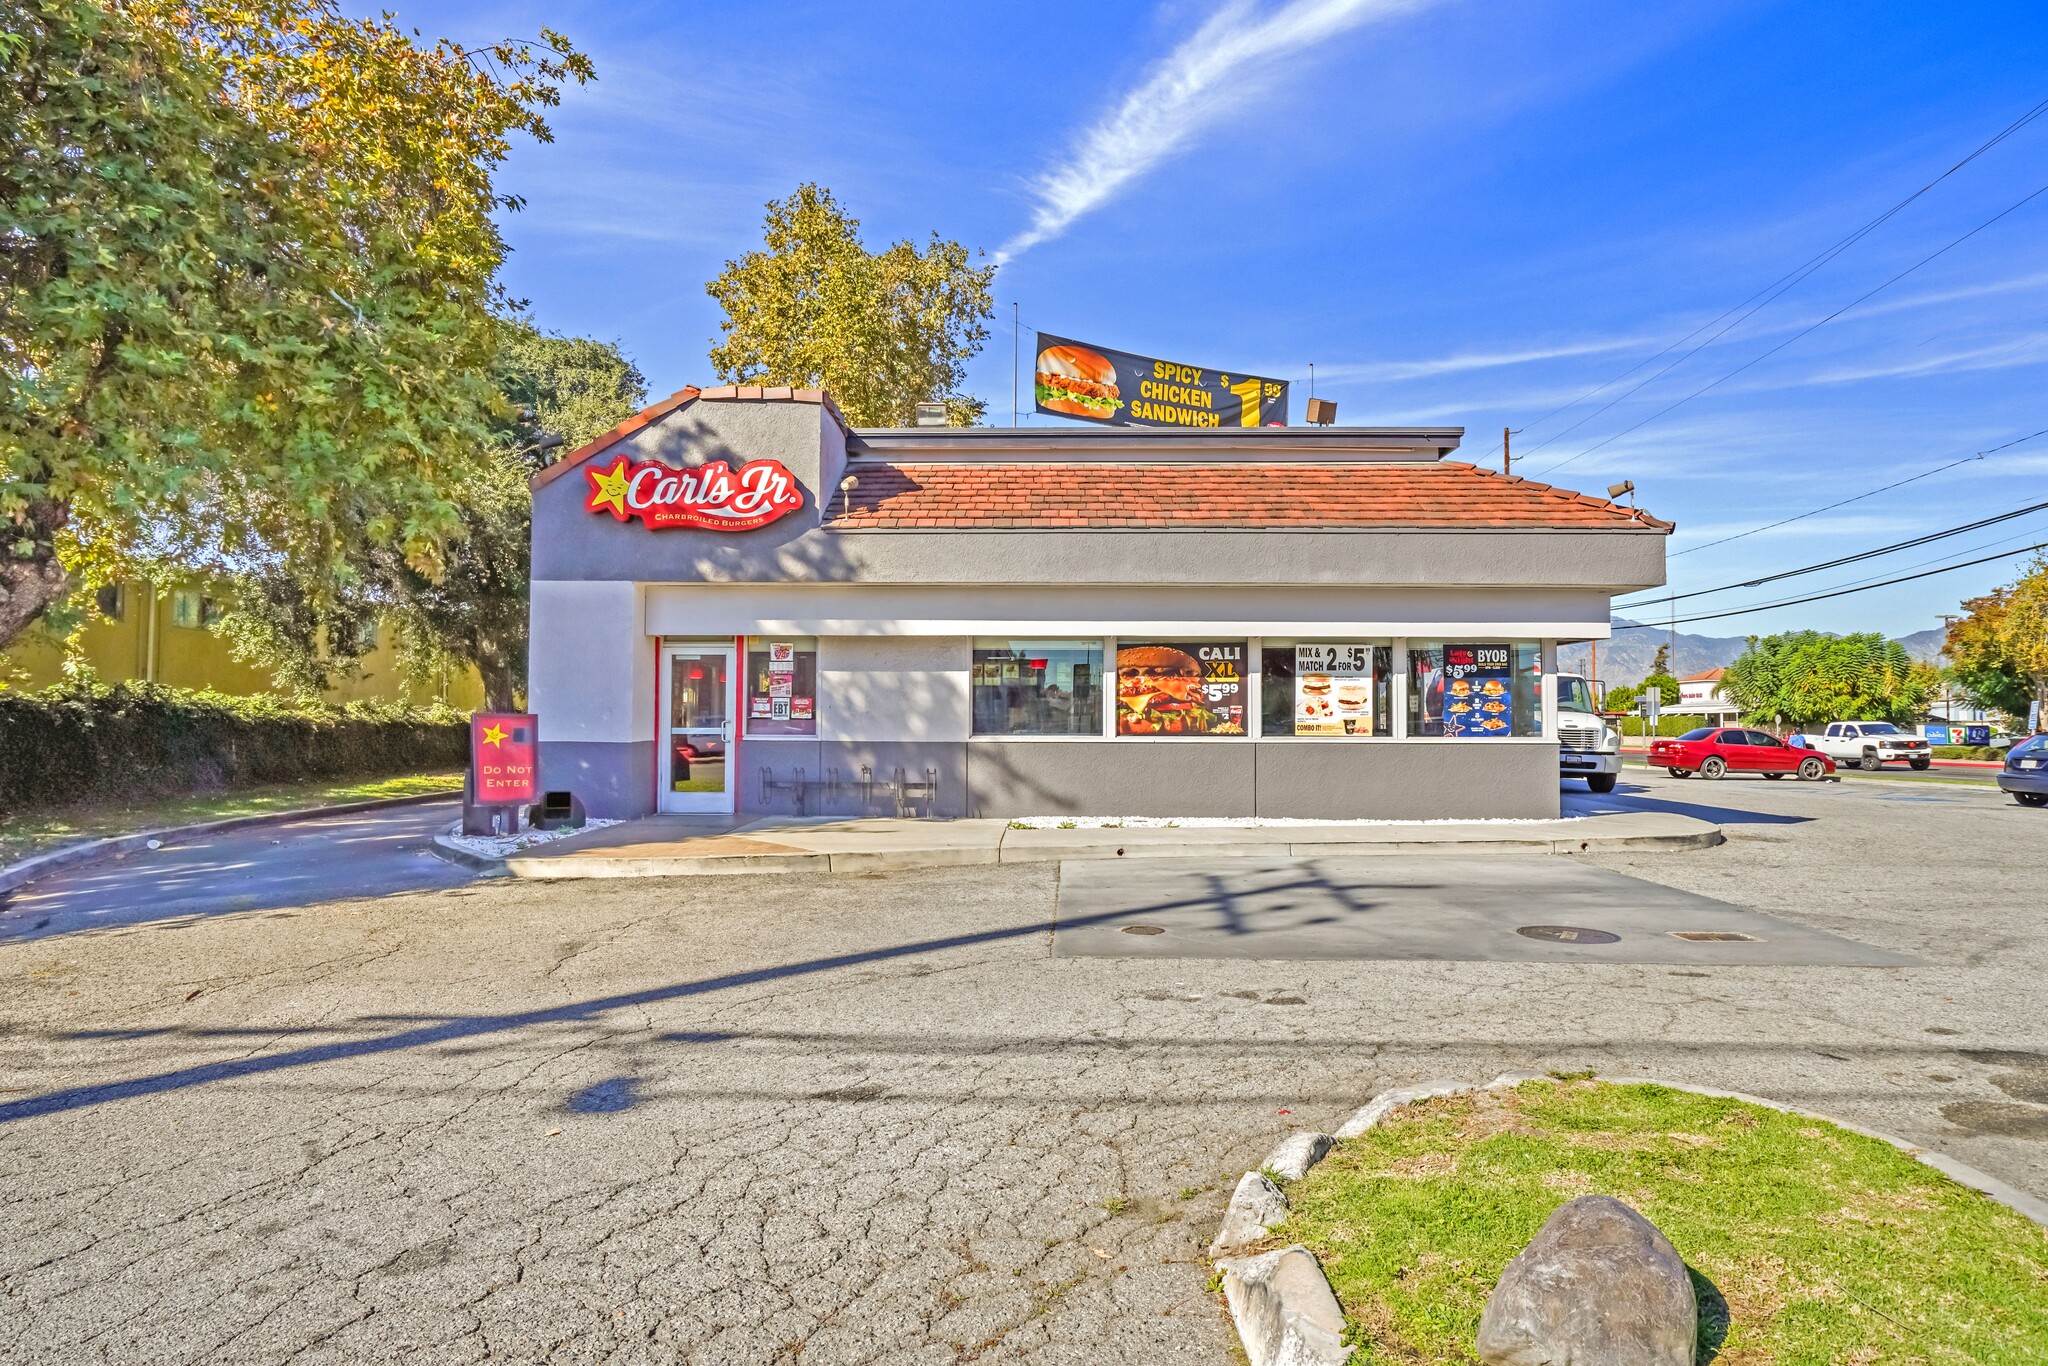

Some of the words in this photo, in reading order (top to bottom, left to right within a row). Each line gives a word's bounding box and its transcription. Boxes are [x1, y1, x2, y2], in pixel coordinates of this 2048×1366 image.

[1153, 361, 1203, 386] SPICY
[1140, 380, 1212, 409] CHICKEN
[1131, 399, 1220, 428] SANDWICH
[626, 466, 736, 509] Carl's
[735, 466, 796, 510] Jr.
[1198, 647, 1240, 660] CALI
[1298, 647, 1313, 658] MIX
[1314, 647, 1321, 658] &
[1326, 647, 1338, 671] 2
[1338, 662, 1352, 671] FOR
[1477, 649, 1508, 663] BYOB
[1205, 661, 1239, 682] XL
[1298, 661, 1324, 672] MATCH
[774, 703, 789, 714] EBT
[486, 779, 529, 787] ENTER
